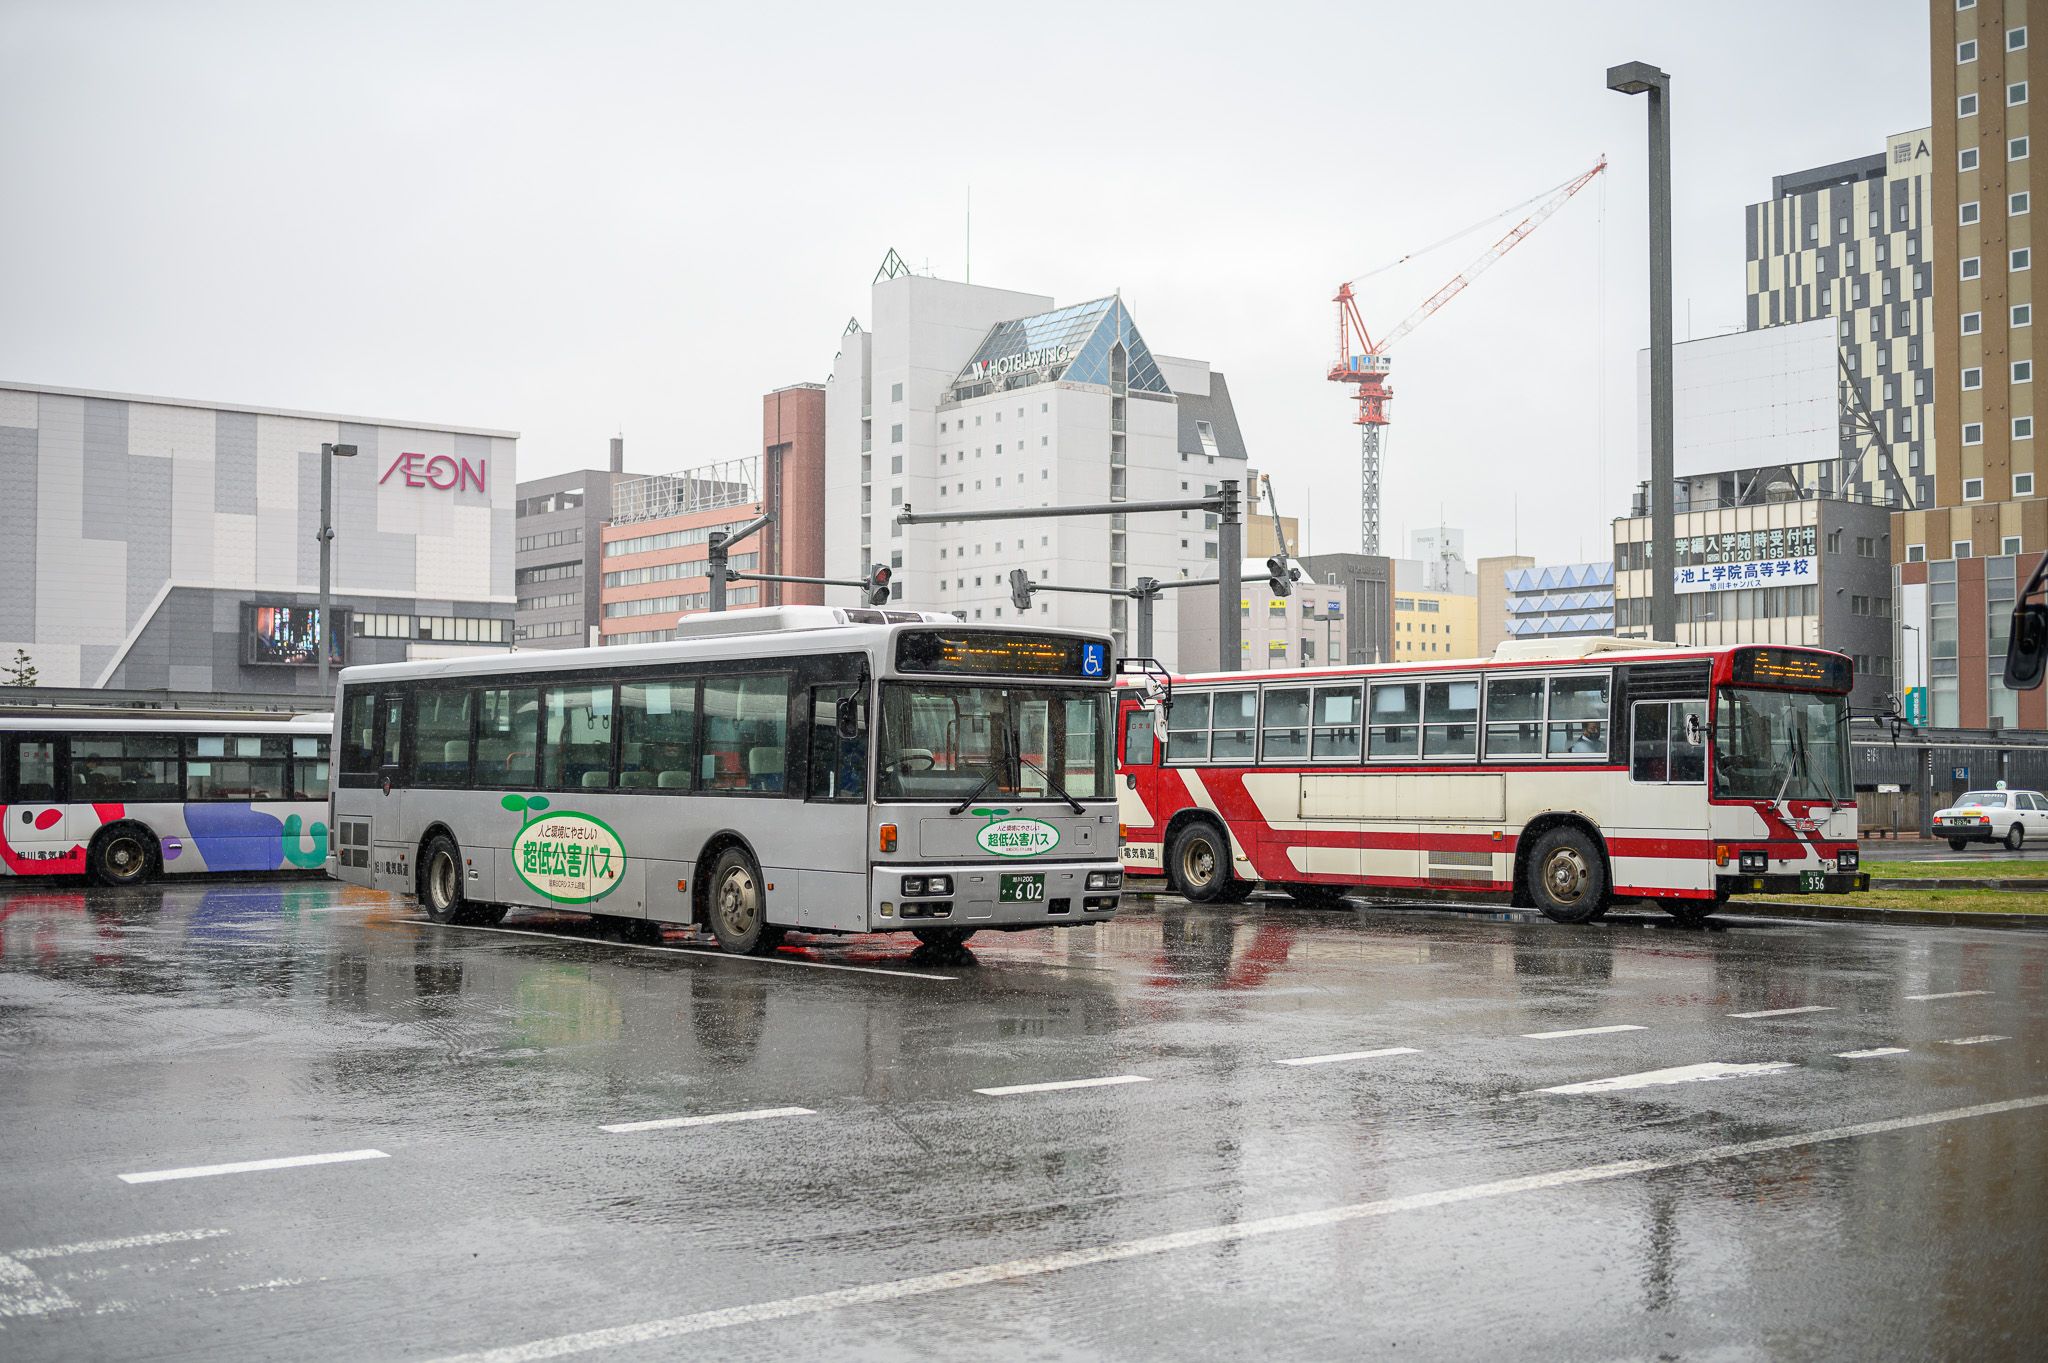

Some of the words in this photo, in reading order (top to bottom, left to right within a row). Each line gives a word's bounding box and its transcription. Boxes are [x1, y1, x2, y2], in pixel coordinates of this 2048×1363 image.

[1721, 543, 1816, 563] 0120-195-315
[1681, 559, 1809, 584] 池上学院高等学校
[1709, 579, 1762, 591] 旭川キャンパス
[538, 824, 598, 840] 人と環境にやさしい
[988, 833, 1049, 847] 超低公害バス
[17, 851, 78, 861] 旭川電気軌道
[523, 841, 611, 878] 超低公害バス
